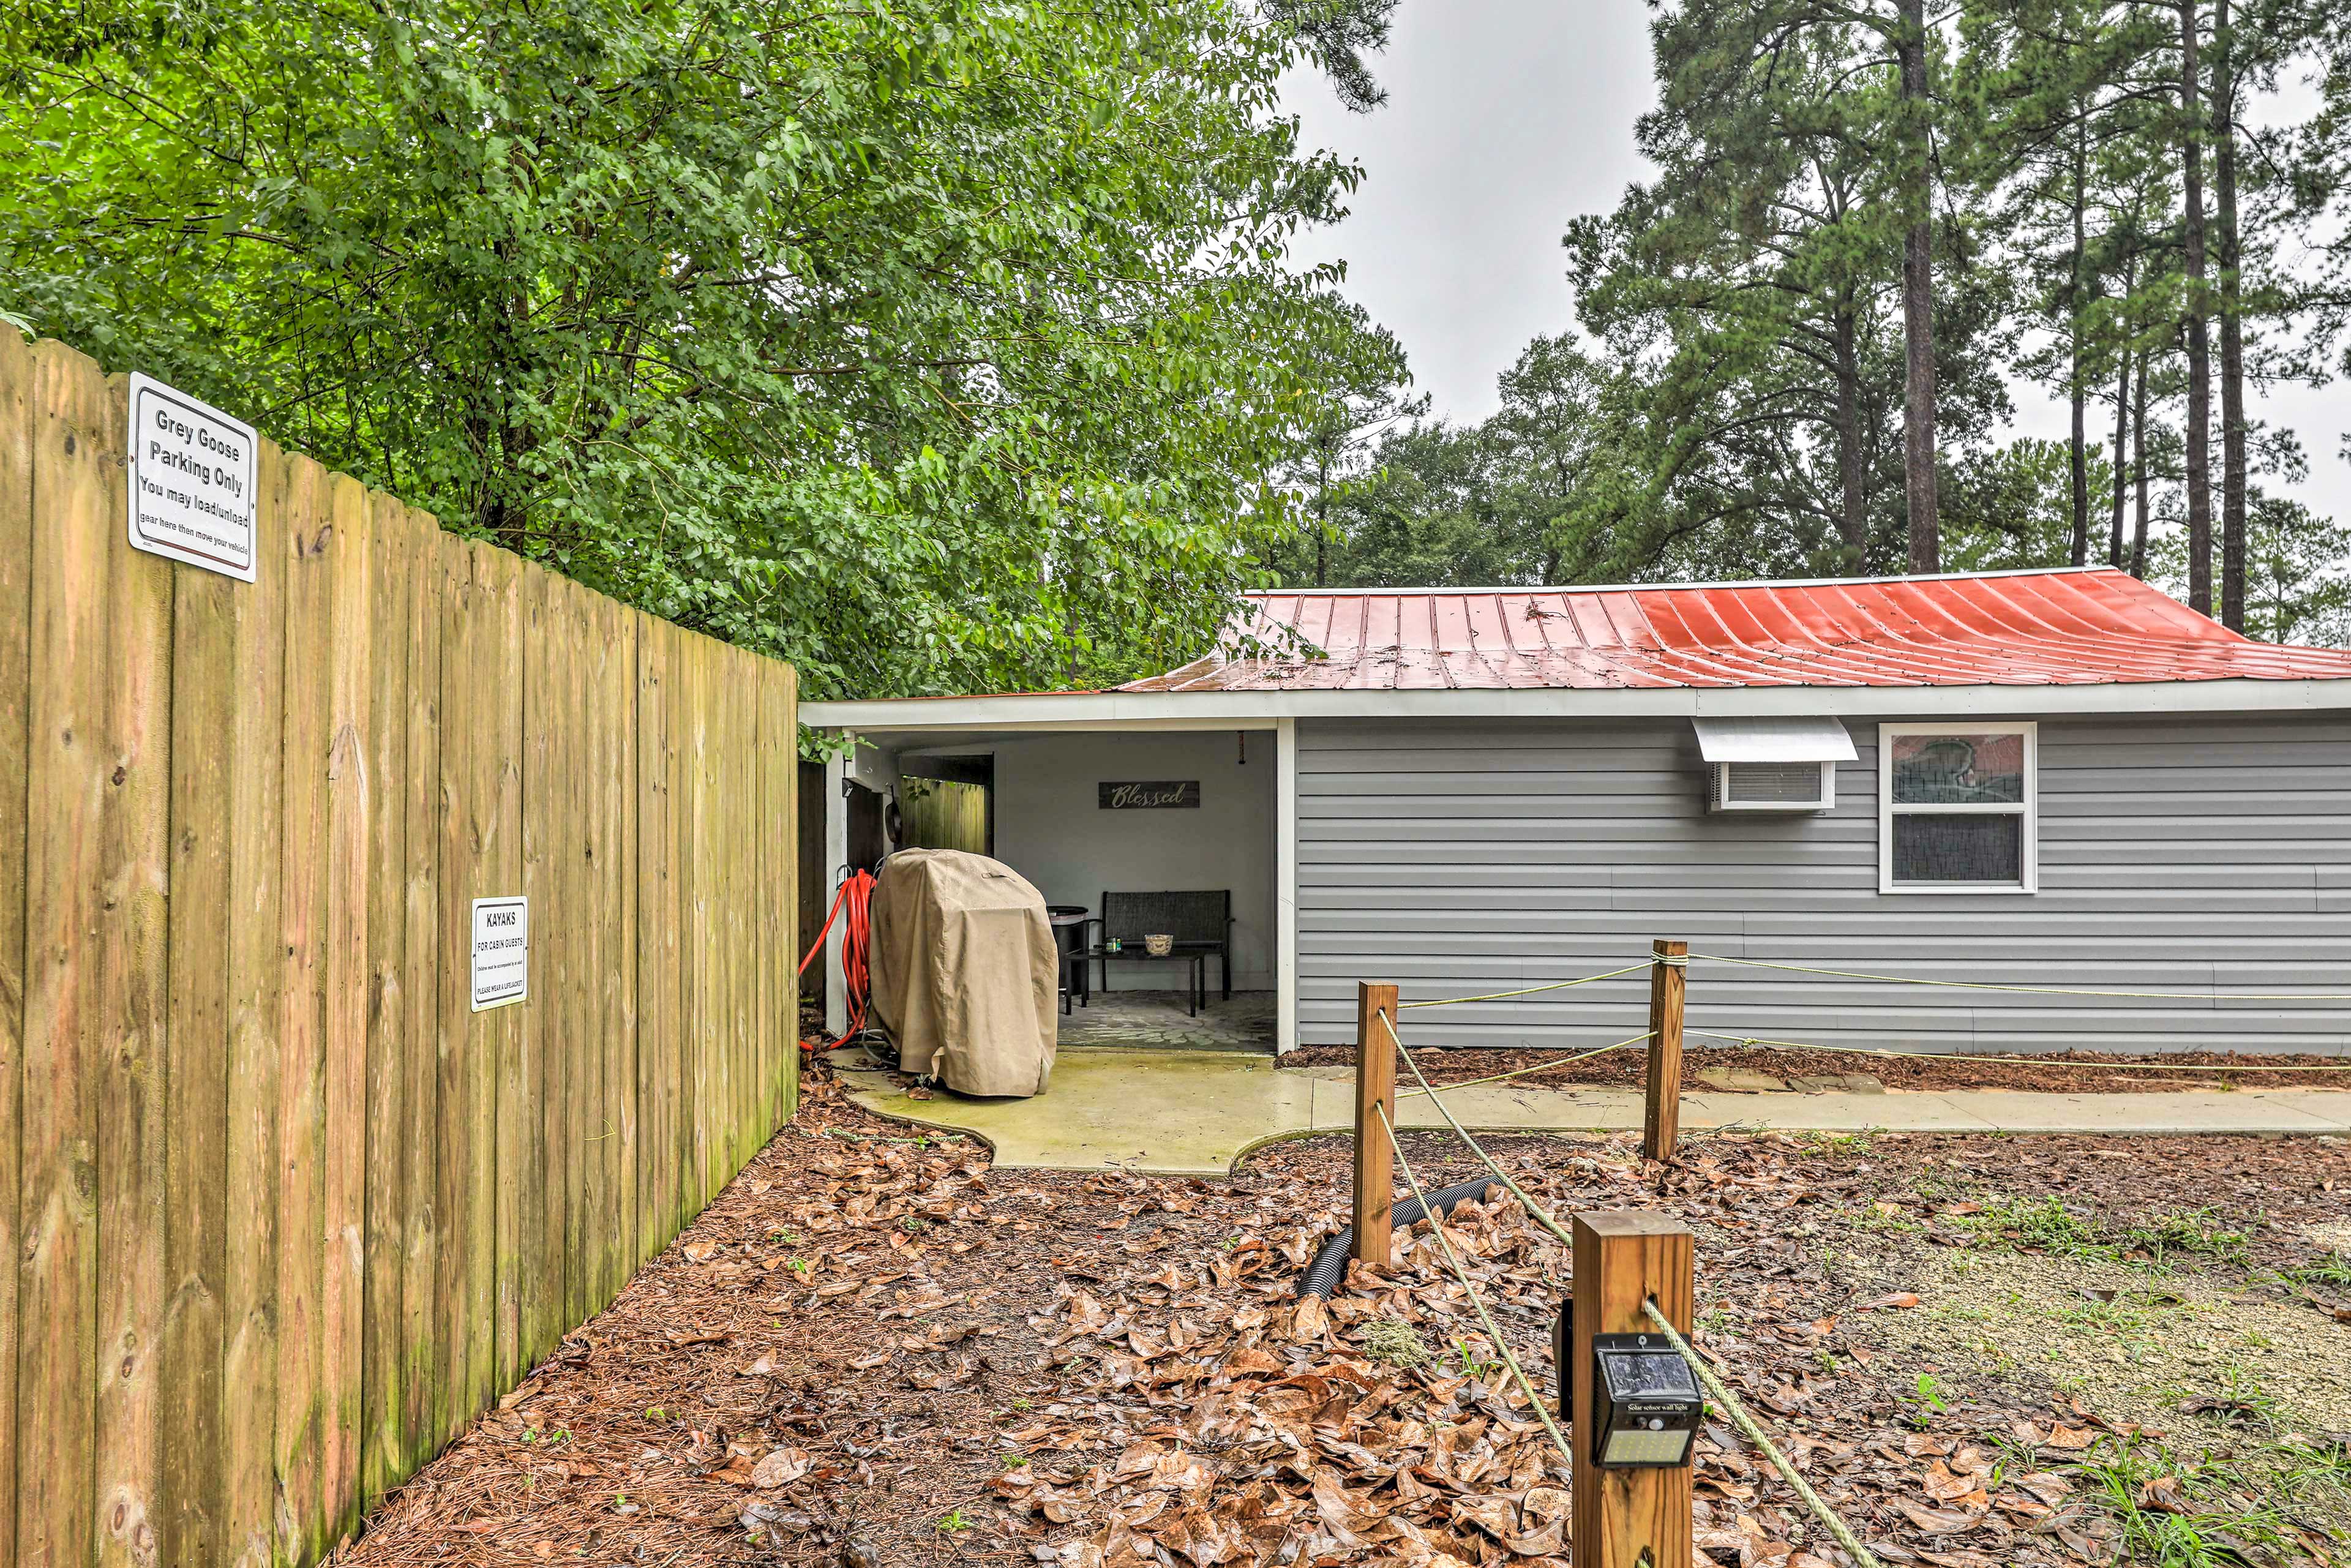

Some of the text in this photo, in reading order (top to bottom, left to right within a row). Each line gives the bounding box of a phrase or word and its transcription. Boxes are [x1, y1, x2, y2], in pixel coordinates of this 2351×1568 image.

[156, 410, 239, 462] Grey Goose
[150, 440, 242, 498] Parking Only
[140, 475, 248, 528] You may load/unload
[140, 513, 248, 555] gear here then move your vehicle
[1112, 783, 1186, 808] Blessed
[487, 911, 516, 928] KAYAKS
[478, 937, 523, 951] FOR CABIN GUESTS
[478, 986, 490, 995] PLEASE
[504, 980, 522, 989] LIFEJACKET
